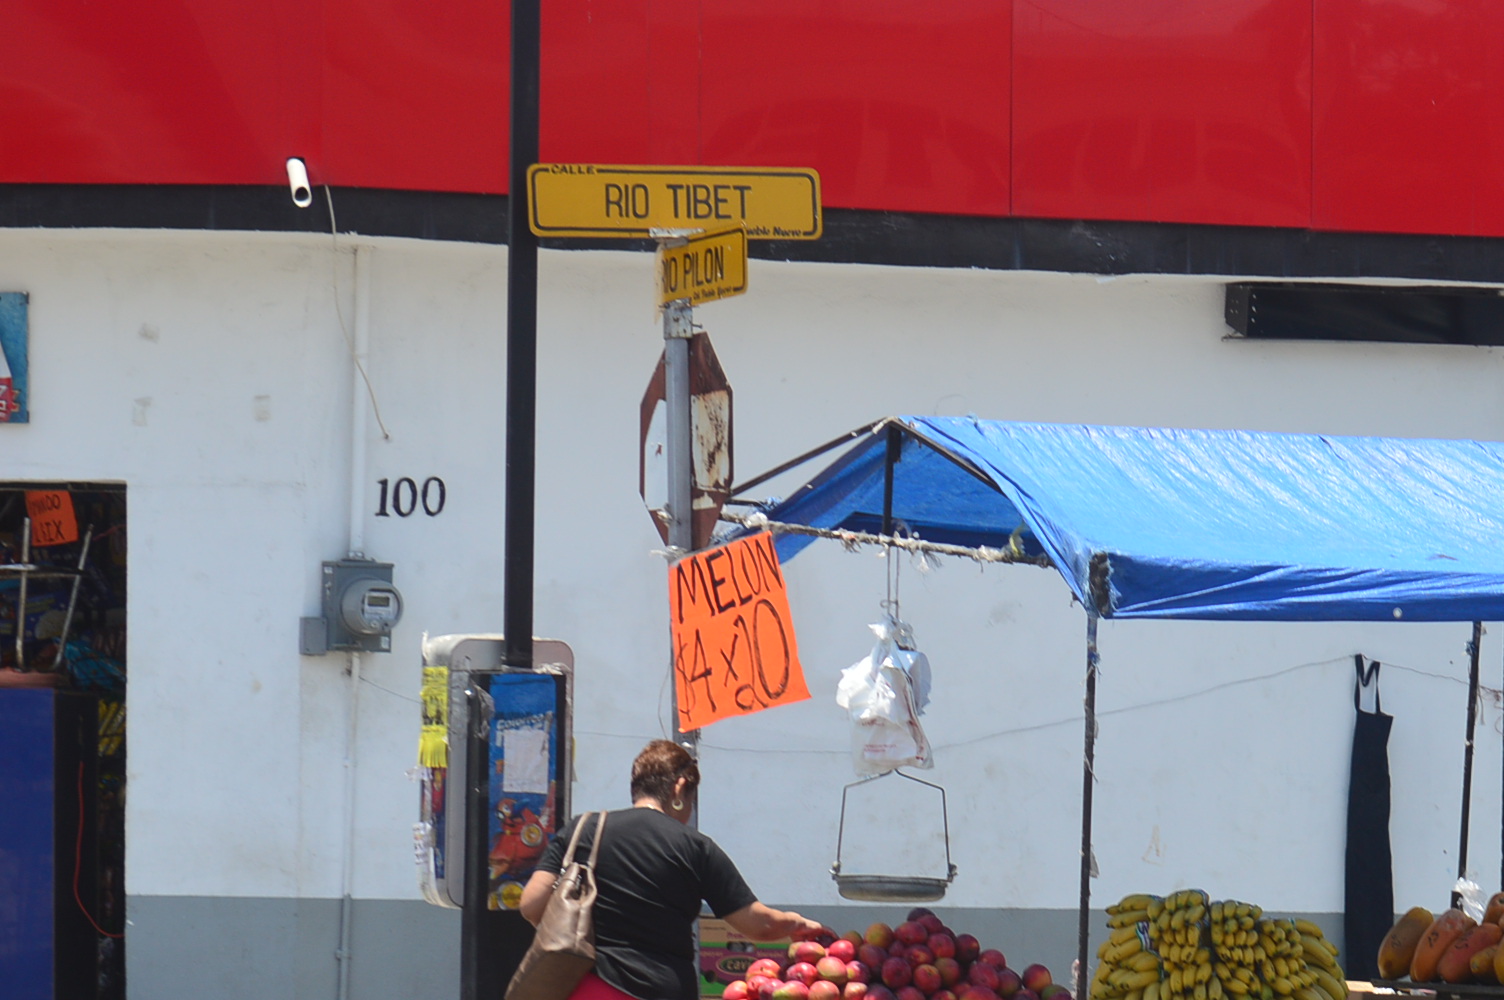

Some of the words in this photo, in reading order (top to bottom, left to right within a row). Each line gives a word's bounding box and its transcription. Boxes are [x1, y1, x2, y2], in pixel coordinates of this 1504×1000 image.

[551, 164, 595, 176] CALLE
[604, 183, 650, 219] RIO
[666, 183, 752, 220] TIBET
[683, 245, 725, 289] PILON
[375, 477, 446, 518] 100
[676, 535, 783, 624] MELON
